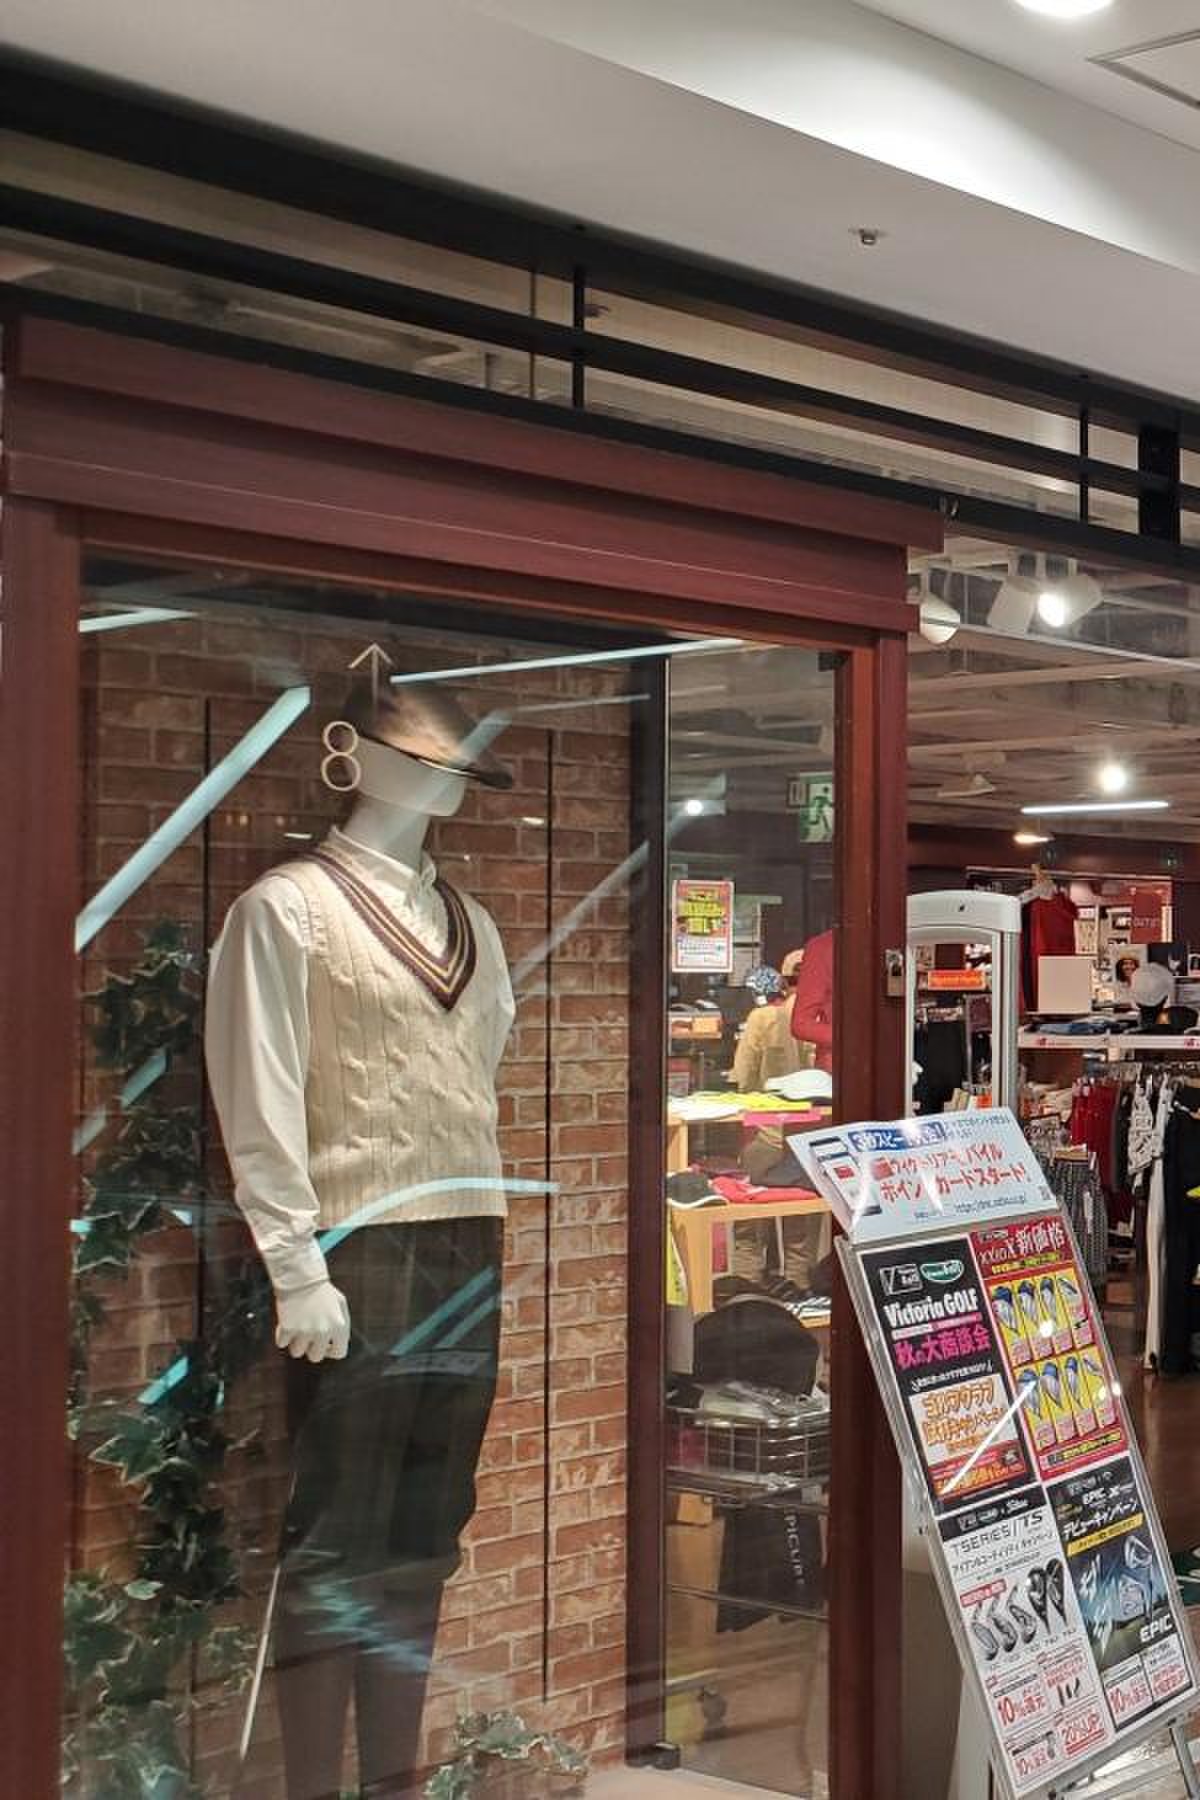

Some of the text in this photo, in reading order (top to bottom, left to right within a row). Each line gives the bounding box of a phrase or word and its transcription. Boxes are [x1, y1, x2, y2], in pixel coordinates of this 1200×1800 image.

[884, 1295, 944, 1329] Victoria
[943, 1287, 979, 1319] GOLF
[1140, 1613, 1173, 1643] EPIC
